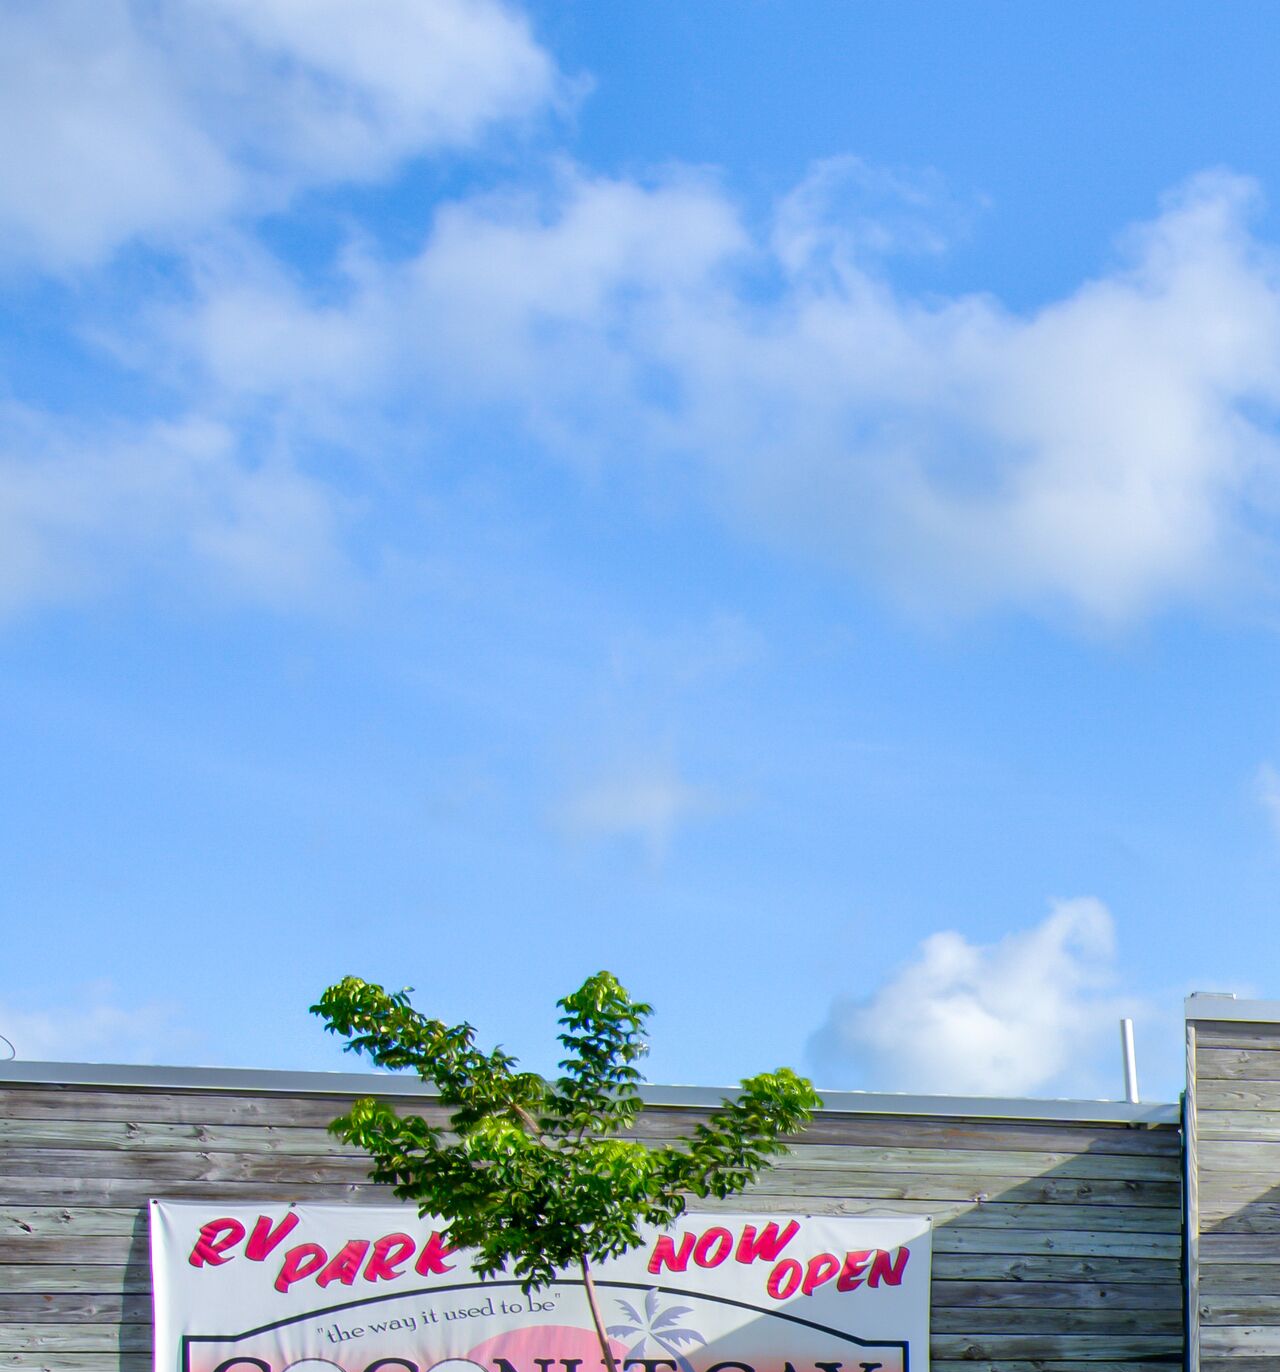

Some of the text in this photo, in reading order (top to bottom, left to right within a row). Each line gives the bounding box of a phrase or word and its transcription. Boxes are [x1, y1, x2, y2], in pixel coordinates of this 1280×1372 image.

[189, 1211, 300, 1268] RV
[274, 1230, 460, 1293] PARK
[648, 1219, 800, 1274] NOW
[767, 1246, 910, 1300] OPEN
[368, 1316, 416, 1337] way
[422, 1309, 439, 1326] it
[445, 1298, 495, 1321] used
[501, 1300, 523, 1314] to
